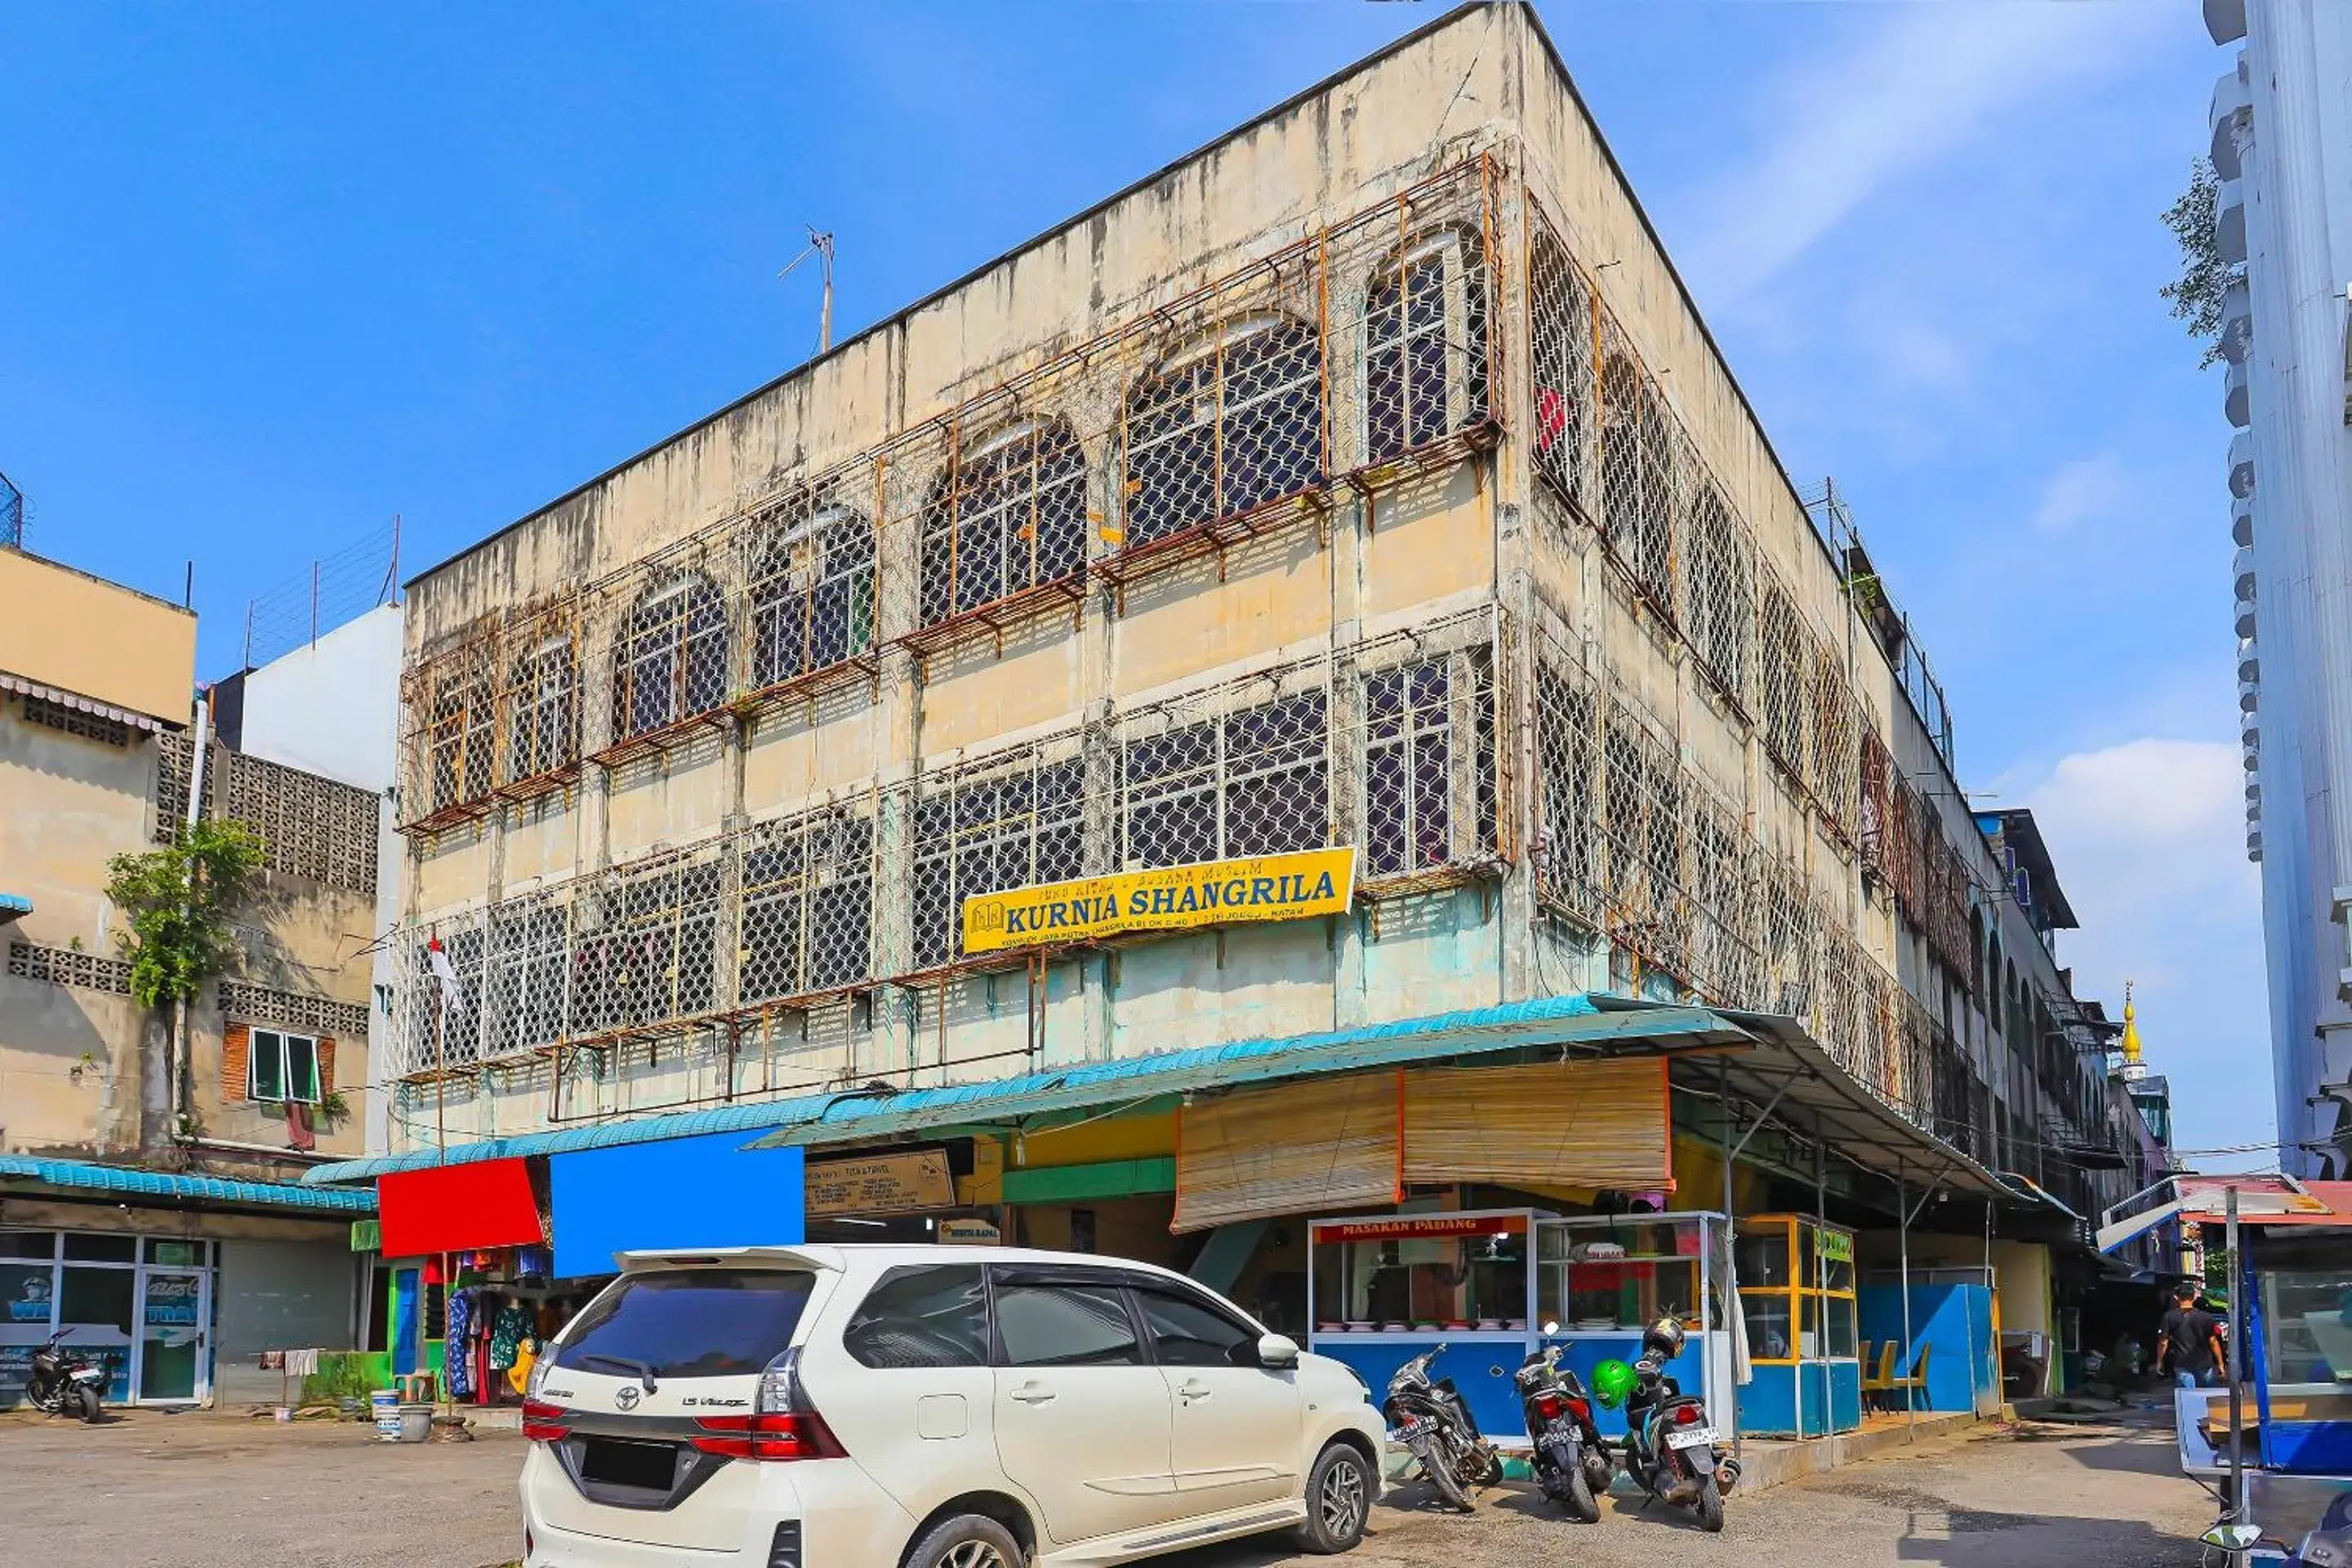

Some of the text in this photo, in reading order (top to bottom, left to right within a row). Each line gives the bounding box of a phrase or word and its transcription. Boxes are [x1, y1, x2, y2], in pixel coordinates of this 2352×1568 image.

[1201, 860, 1263, 880] MUSLIM
[1006, 893, 1119, 933] KURNIA
[1129, 871, 1335, 915] SHANGRILA
[1136, 916, 1162, 928] BLOK
[1343, 1219, 1477, 1235] MASAKAN PADANG
